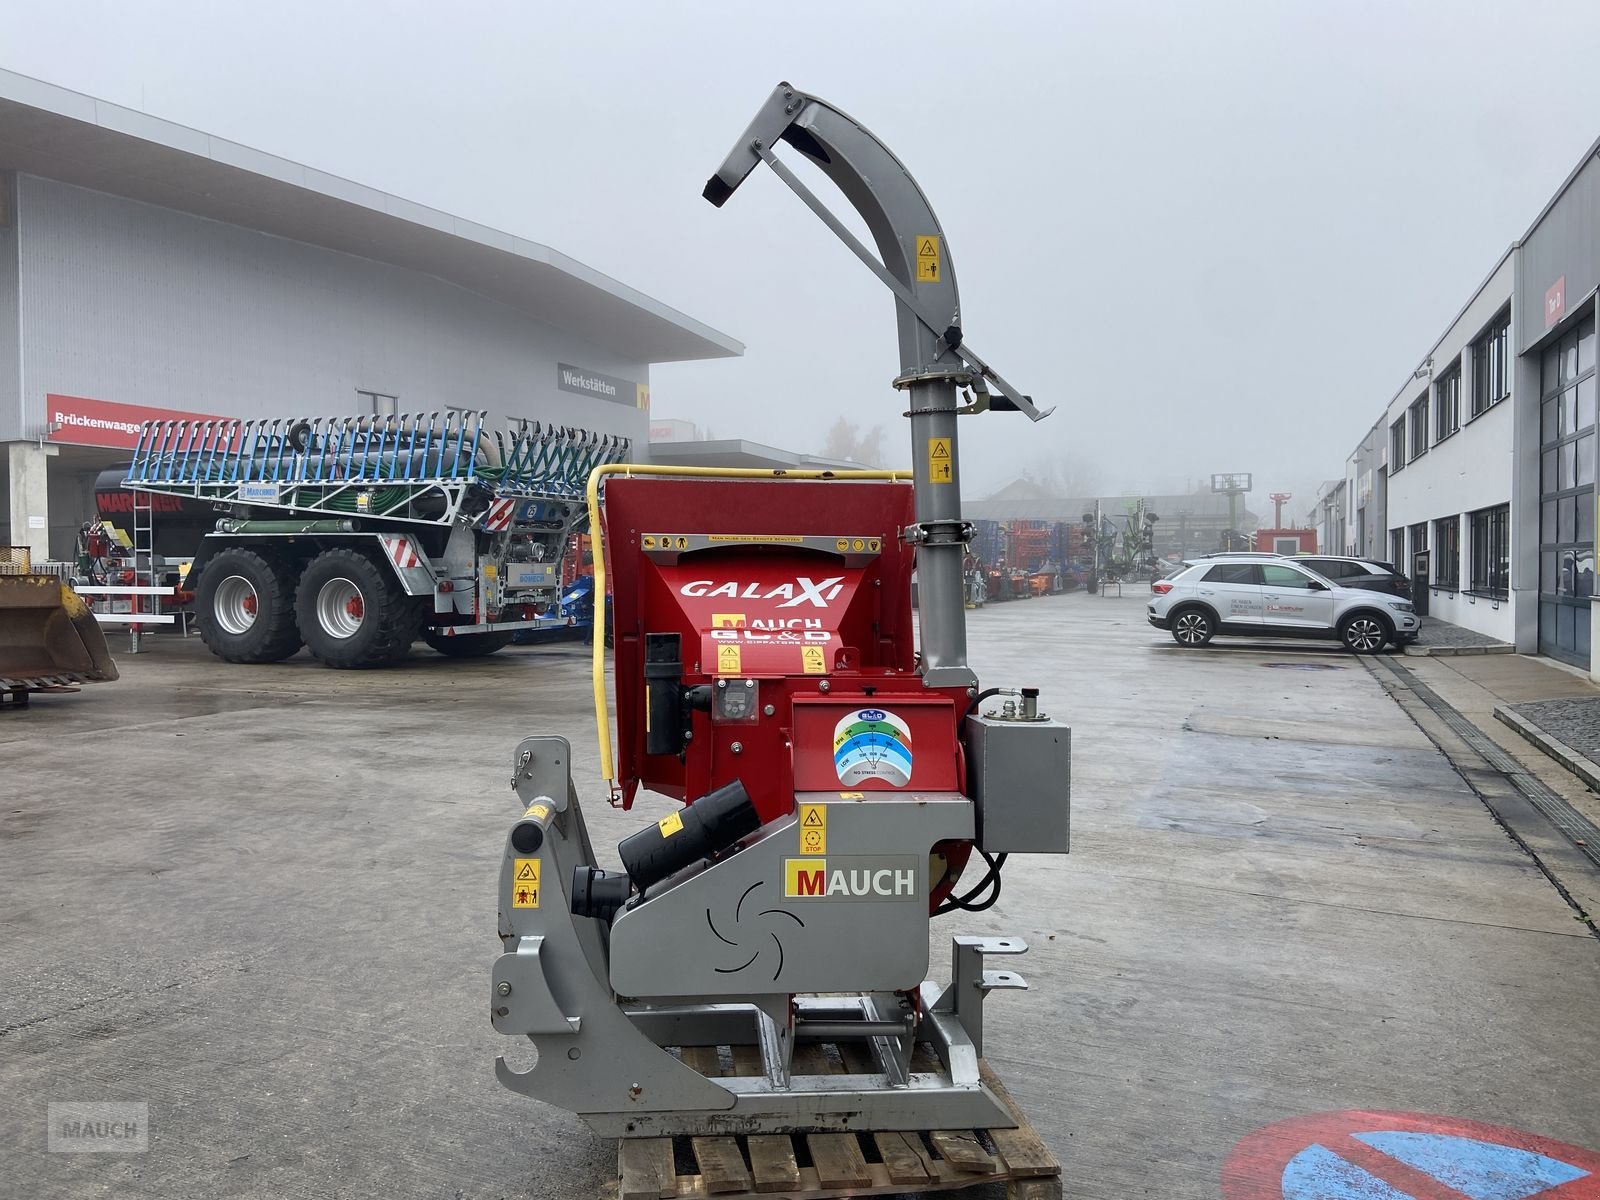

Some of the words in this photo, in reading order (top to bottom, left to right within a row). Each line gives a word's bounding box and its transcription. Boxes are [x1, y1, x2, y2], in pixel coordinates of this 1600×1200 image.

[563, 370, 616, 396] Werkstätten
[55, 412, 141, 434] Brückenwaage
[797, 869, 914, 896] MAUCH
